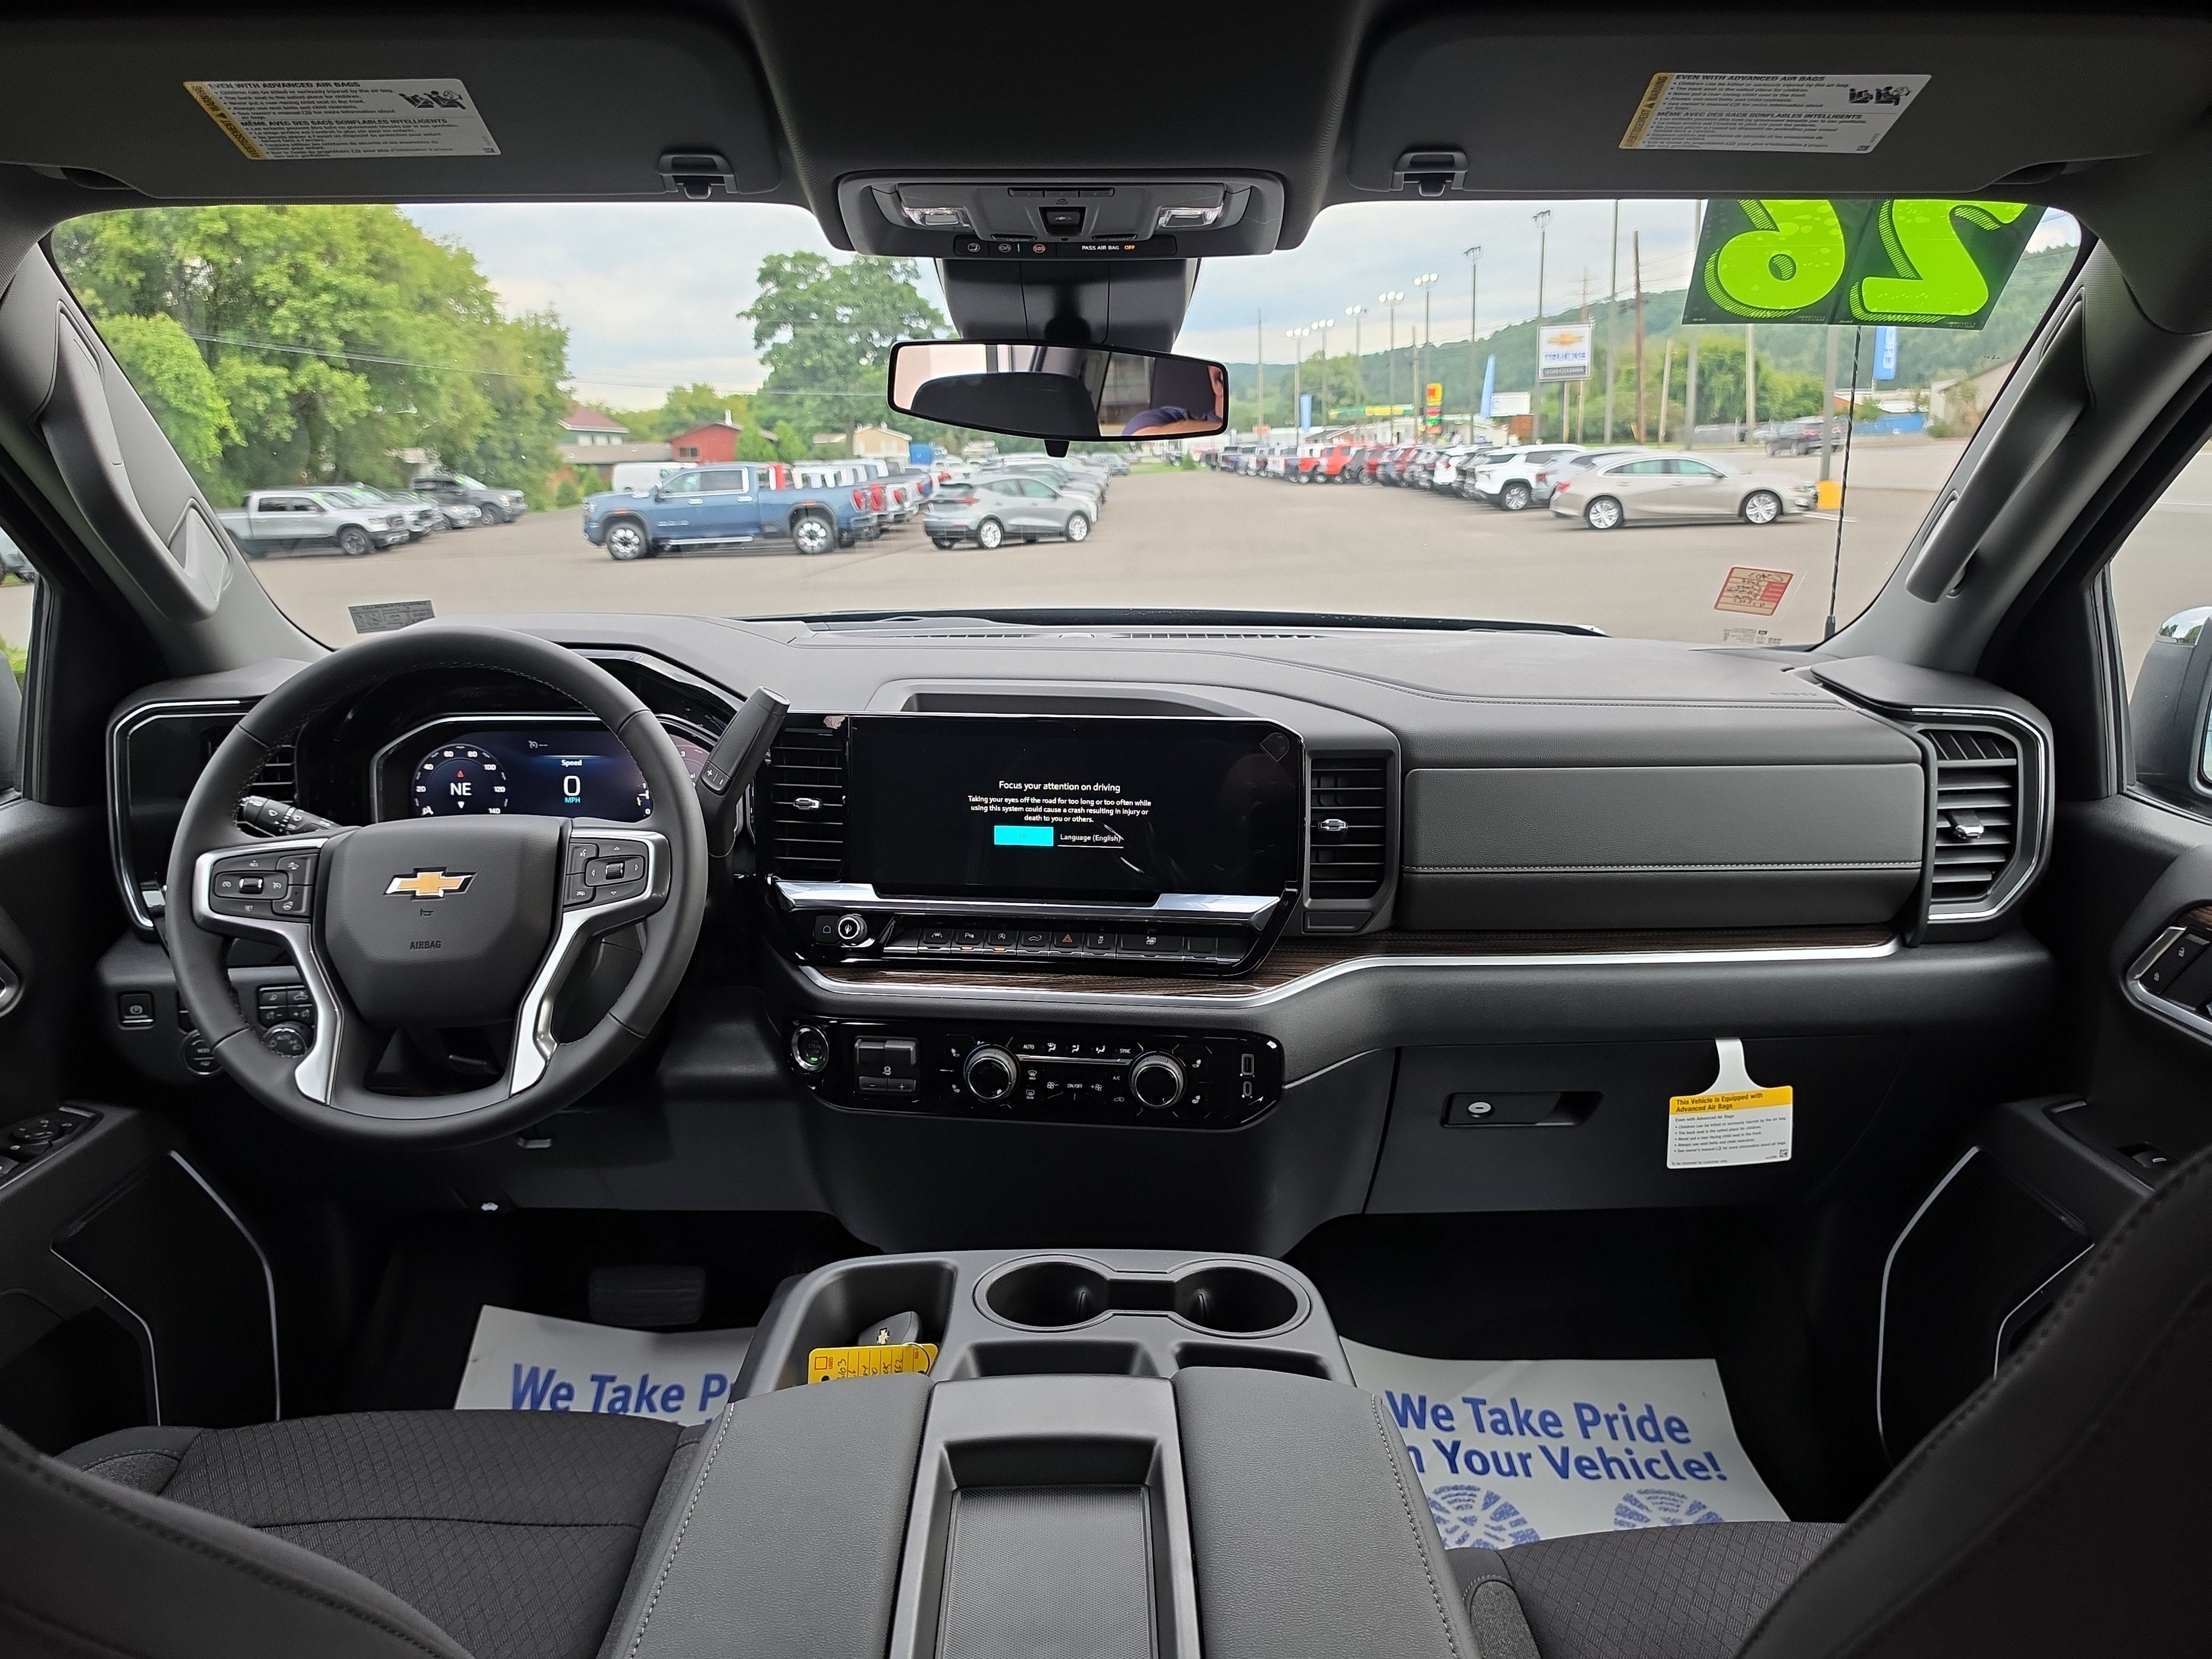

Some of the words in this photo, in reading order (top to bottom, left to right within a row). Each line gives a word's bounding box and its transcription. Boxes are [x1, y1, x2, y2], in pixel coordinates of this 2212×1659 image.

[450, 782, 472, 795] NE
[563, 775, 581, 797] 0
[999, 781, 1023, 789] Focus
[1024, 783, 1042, 792] your
[1043, 782, 1079, 791] attention
[1092, 782, 1121, 793] driving
[968, 795, 988, 803] Taking
[989, 796, 1004, 805] your
[1080, 797, 1095, 806] long
[1116, 798, 1133, 806] often
[1134, 798, 1152, 806] while
[970, 805, 988, 813] using
[1002, 806, 1024, 814] system
[1068, 806, 1085, 814] crash
[1086, 806, 1114, 815] resulting
[1122, 808, 1140, 816] injury
[1060, 834, 1091, 842] Language
[410, 941, 441, 949] AIRBAG
[1721, 1094, 1748, 1102] Equipped
[511, 1363, 575, 1411] We
[590, 1373, 685, 1414] Take
[1385, 1390, 1455, 1432] We
[1462, 1396, 1563, 1439] Take
[1573, 1401, 1692, 1444] Pride
[1407, 1444, 1425, 1473] n
[1431, 1438, 1532, 1479] Your
[1539, 1444, 1728, 1482] Vehicle!
